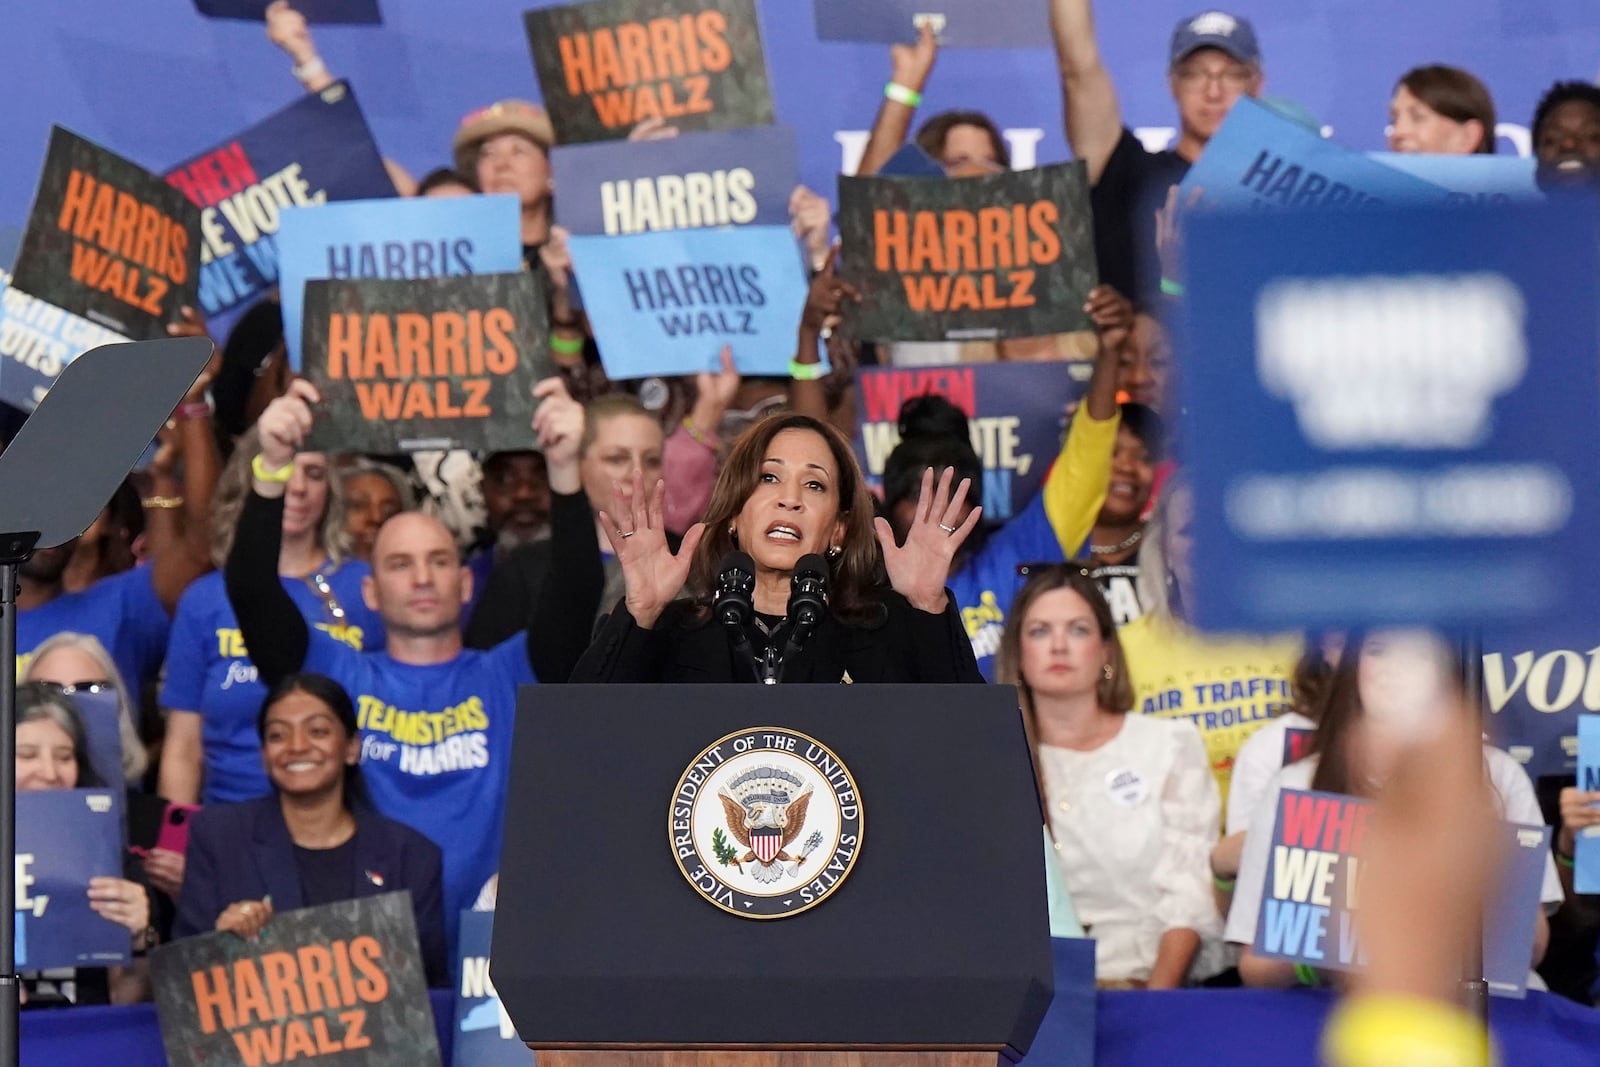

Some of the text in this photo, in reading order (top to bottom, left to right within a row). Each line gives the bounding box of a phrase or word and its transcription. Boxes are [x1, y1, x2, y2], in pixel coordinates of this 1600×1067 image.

[558, 9, 732, 95] HARRIS
[593, 75, 714, 128] WALZ
[58, 170, 189, 284] HARRIS
[600, 167, 757, 236] HARRIS
[327, 238, 475, 279] HARRIS
[873, 200, 1061, 272] HARRIS
[71, 243, 168, 316] WALZ
[623, 263, 767, 312] HARRIS
[902, 270, 1036, 312] WALZ
[328, 307, 518, 380] HARRIS
[658, 310, 758, 337] WALZ
[355, 379, 492, 420] WALZ
[1141, 689, 1182, 714] AIR
[1193, 678, 1294, 704] TRAFFI
[357, 695, 489, 745] TEAMSTERS
[733, 736, 755, 753] OF
[763, 735, 797, 751] THE
[360, 732, 489, 776] for HARRIS
[805, 743, 858, 820] UNITED
[673, 747, 725, 860] PRESIDENT
[690, 865, 735, 908] VICE
[799, 833, 857, 904] STATES
[1274, 845, 1339, 906] WE
[1264, 899, 1330, 960] WE
[191, 935, 389, 1034] HARRIS
[233, 1009, 372, 1067] WALZ
